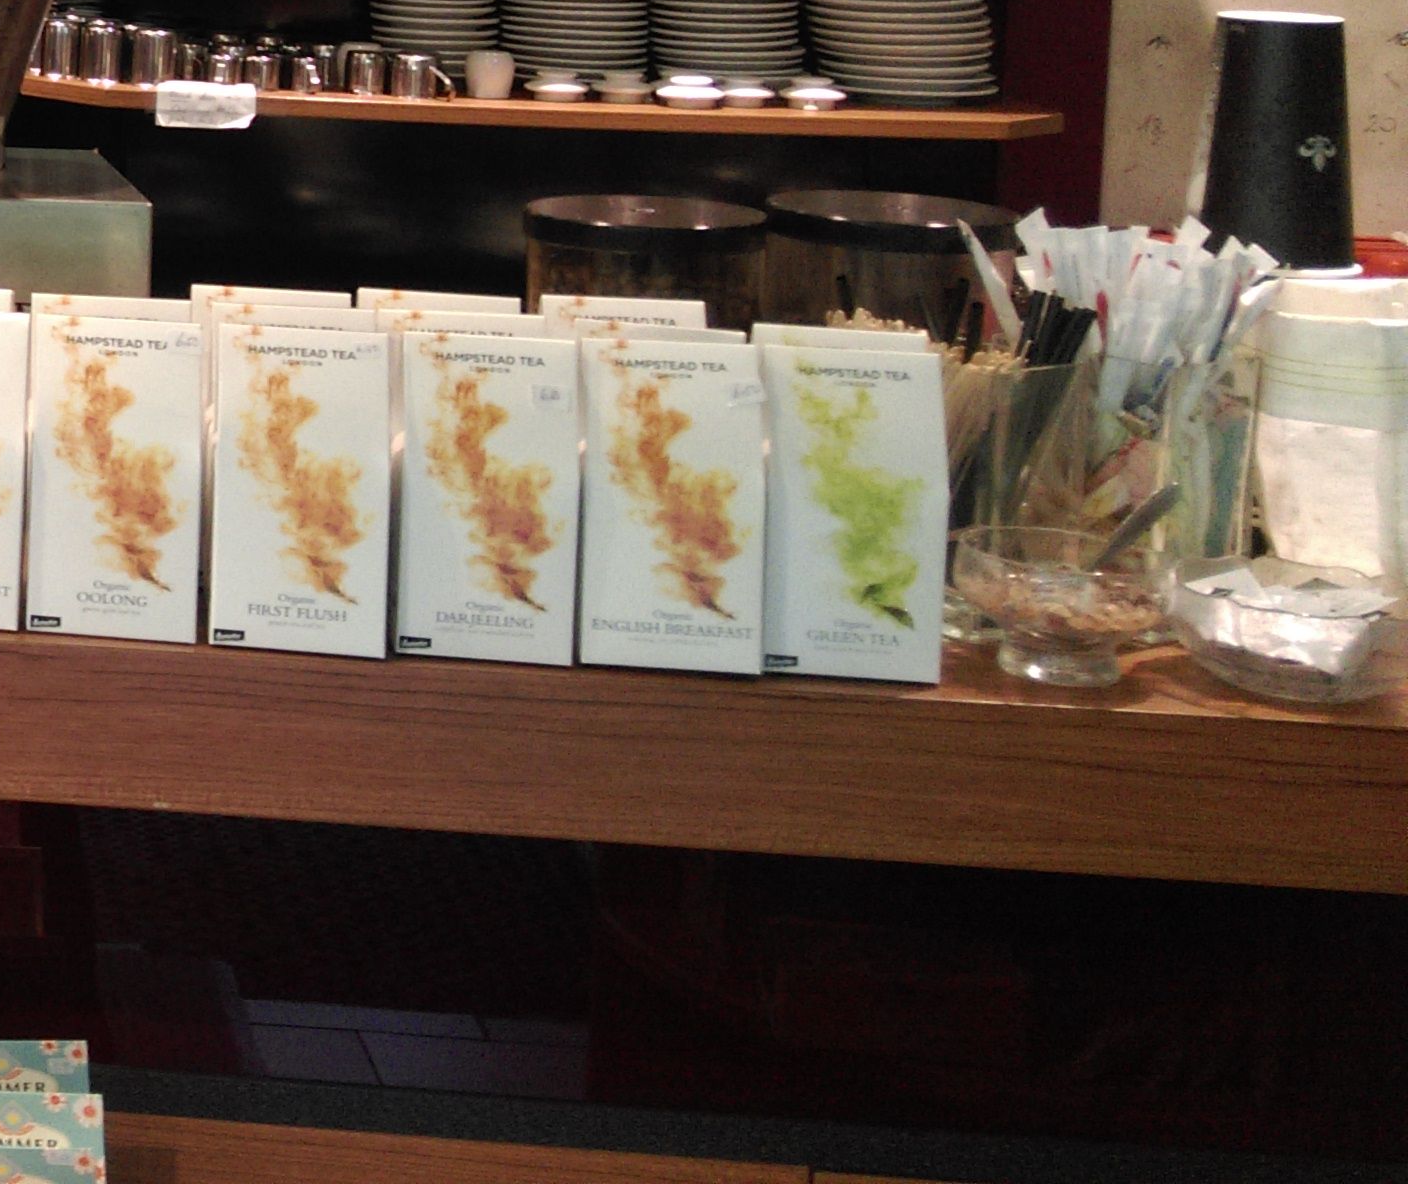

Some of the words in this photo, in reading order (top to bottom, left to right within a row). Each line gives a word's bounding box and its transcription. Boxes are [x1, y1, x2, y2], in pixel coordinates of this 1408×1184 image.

[66, 334, 143, 349] HAMPSTEAD
[248, 345, 328, 360] HAMPSTEAD
[331, 349, 357, 361] TEA
[435, 352, 516, 366] HAMPSTEAD
[520, 356, 545, 367] TEA
[615, 358, 697, 372] HAMPSTEAD
[701, 362, 727, 372] TEA
[798, 366, 882, 380] HAMPSTEAD
[884, 370, 911, 381] TEA
[93, 579, 130, 592] Organic
[76, 591, 148, 608] OOLONG
[277, 593, 316, 605] Organic
[248, 603, 291, 618] FIRST
[297, 606, 348, 622] FLUSH
[435, 611, 534, 630] DARJEELING
[591, 617, 660, 634] ENGLISH
[665, 622, 754, 641] BREAKFAST
[806, 629, 865, 645] GREEN
[869, 634, 900, 647] TEA
